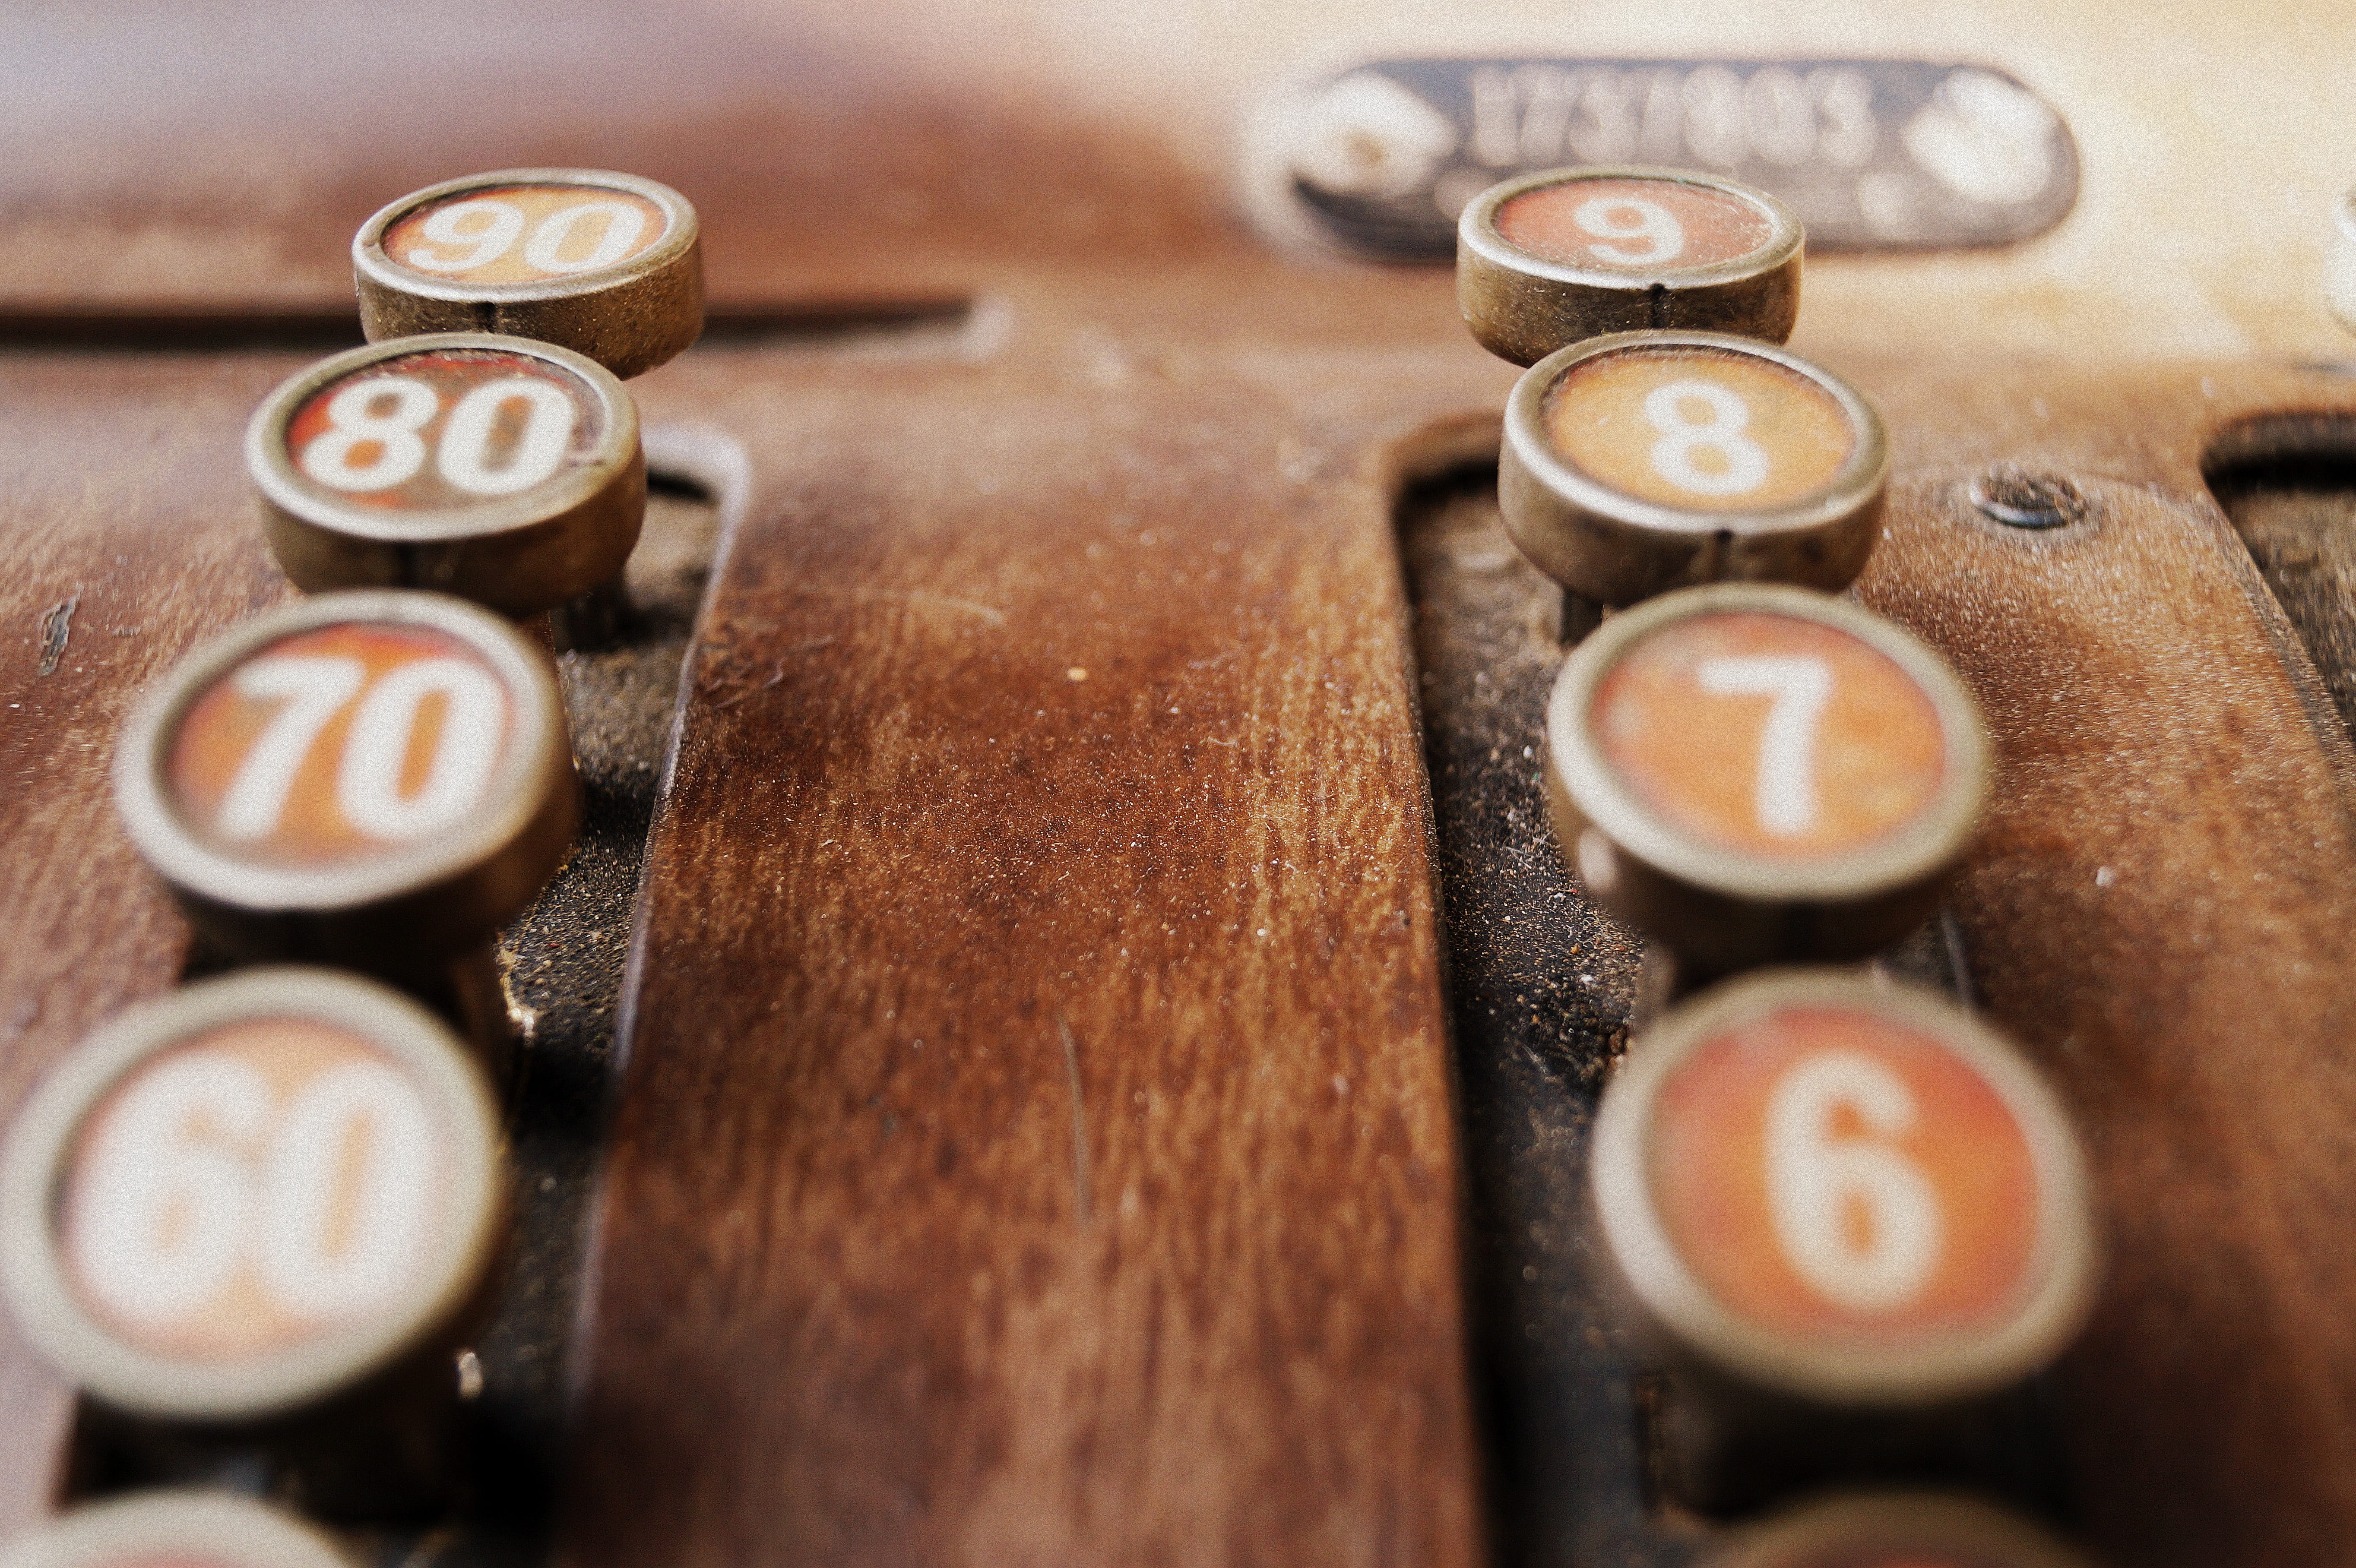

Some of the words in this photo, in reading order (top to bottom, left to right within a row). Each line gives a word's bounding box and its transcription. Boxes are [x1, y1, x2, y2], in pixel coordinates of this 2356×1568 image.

[409, 200, 645, 273] 90
[1574, 198, 1684, 265] 9
[301, 376, 573, 495] 80
[1644, 381, 1770, 496] 8
[215, 654, 505, 840] 70
[1697, 656, 1834, 839] 7
[67, 1050, 428, 1320] 60
[1765, 1048, 1946, 1311] 6
